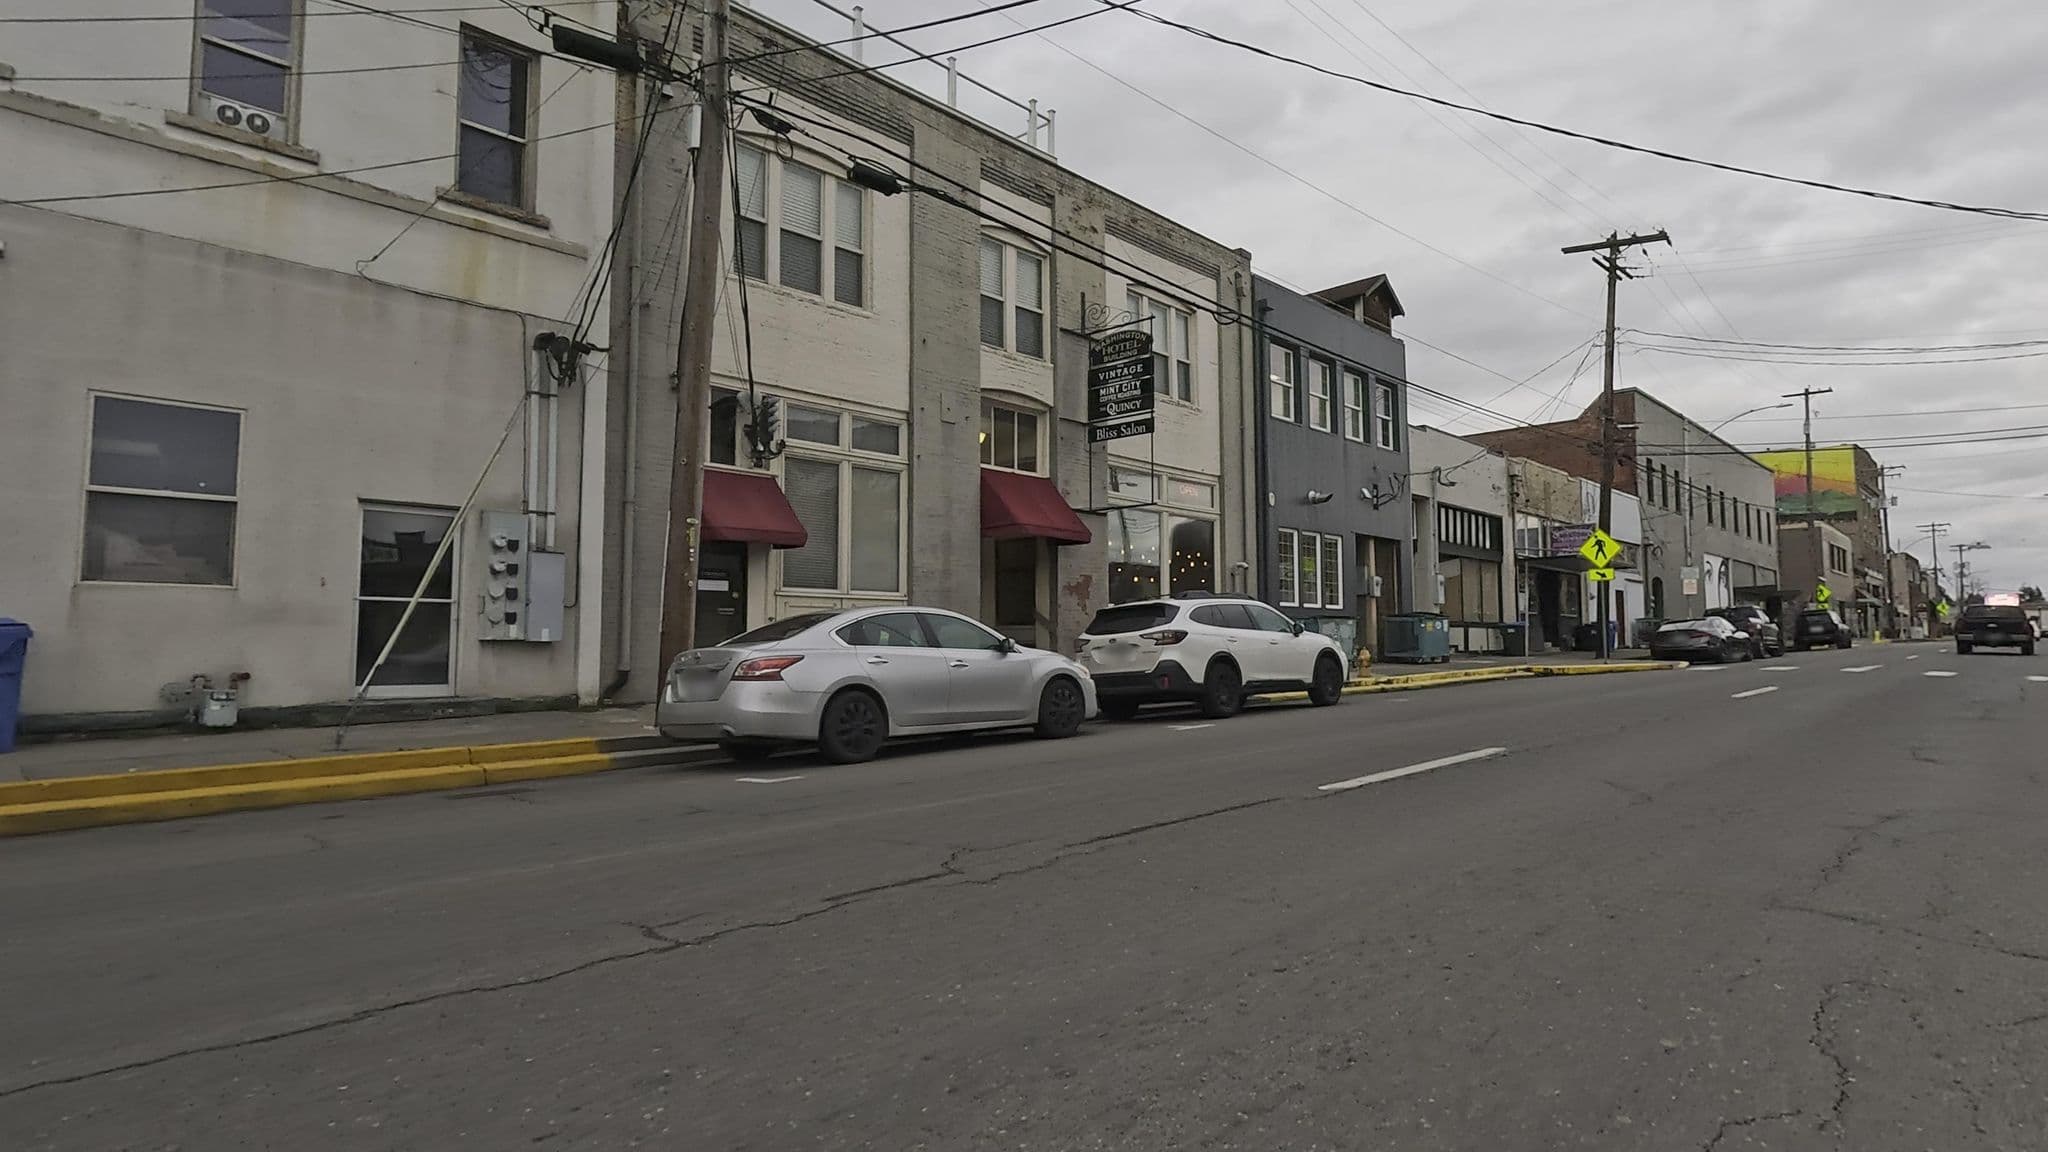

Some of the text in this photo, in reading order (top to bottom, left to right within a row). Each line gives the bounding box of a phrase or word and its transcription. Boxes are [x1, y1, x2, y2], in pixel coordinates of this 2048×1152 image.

[1102, 340, 1141, 355] HOTEL
[1103, 349, 1138, 362] BUILDING
[1098, 364, 1143, 380] VINTAGE
[1100, 380, 1141, 396] MINT CITY
[1096, 423, 1146, 440] Bliss Salon
